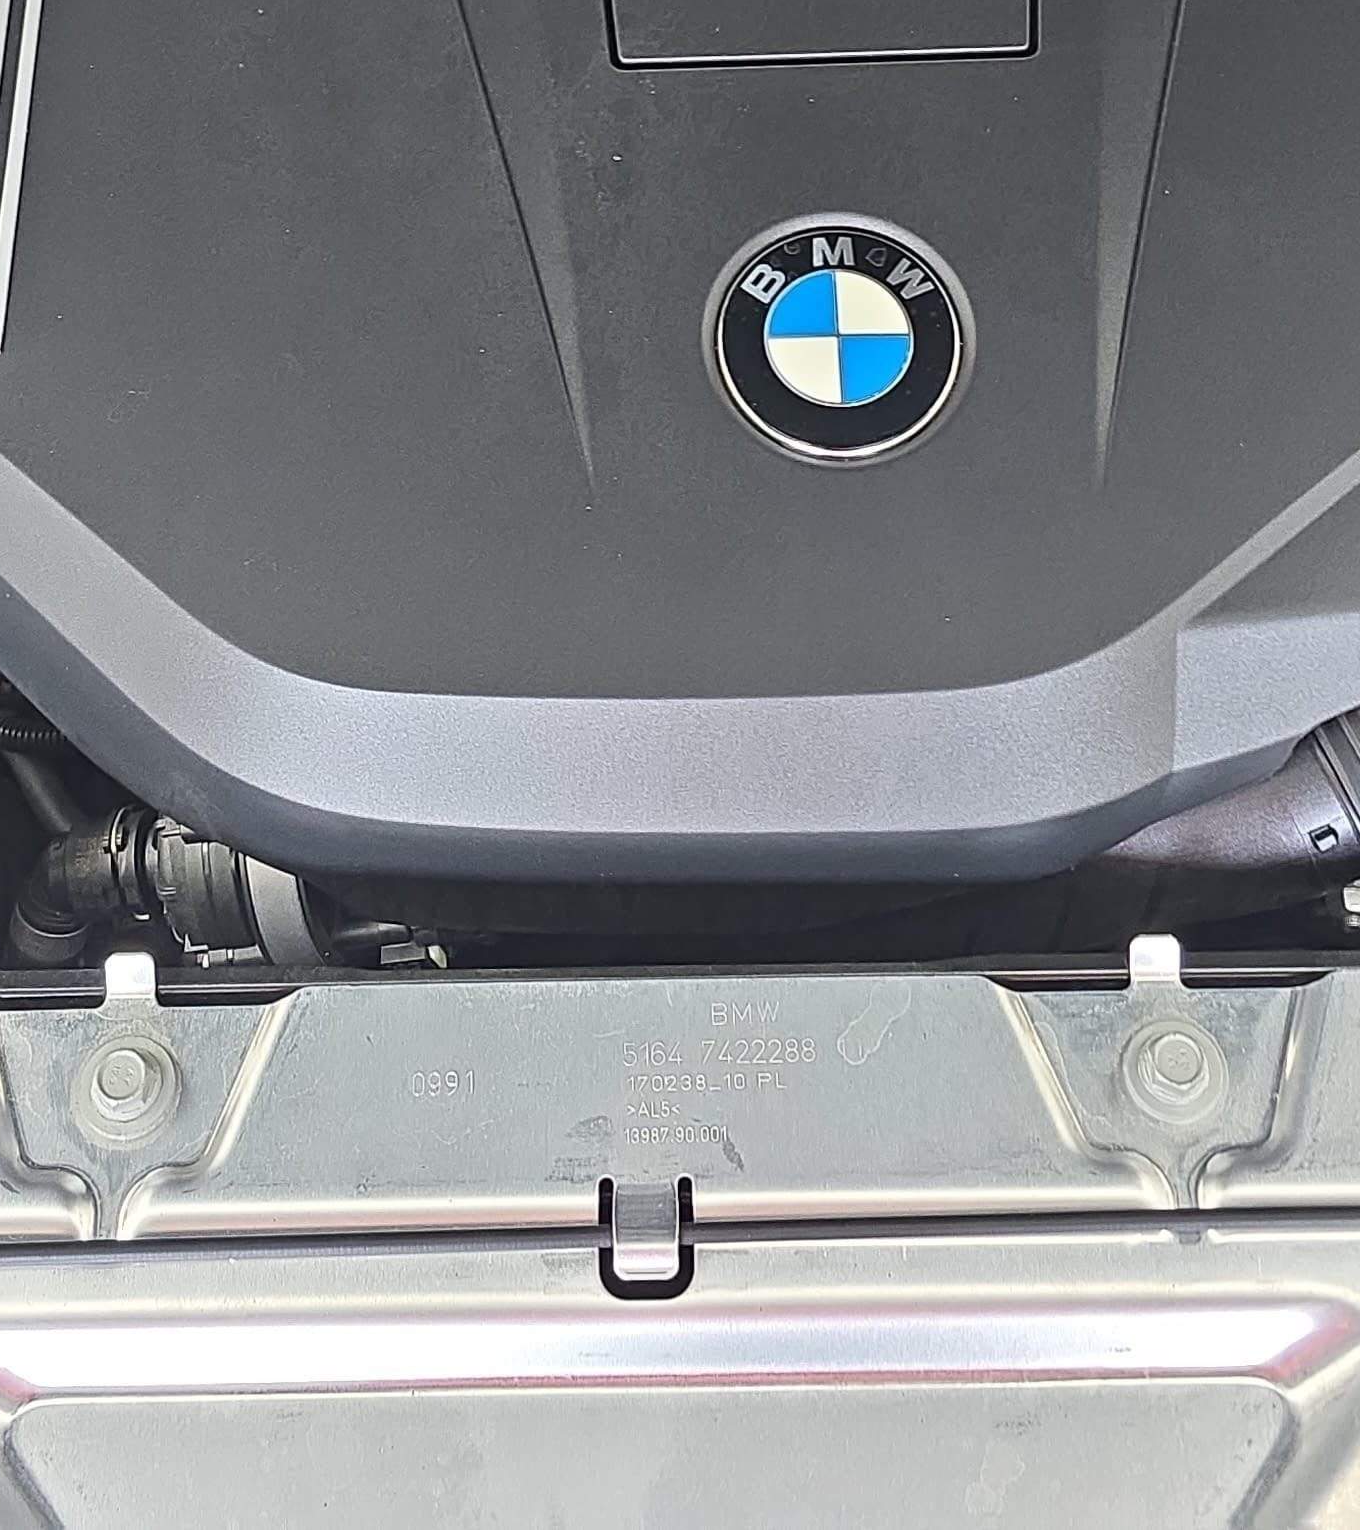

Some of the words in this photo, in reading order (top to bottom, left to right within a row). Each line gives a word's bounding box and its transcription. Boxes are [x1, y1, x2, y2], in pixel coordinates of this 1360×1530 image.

[740, 236, 936, 304] BMW
[711, 1001, 780, 1027] BMW
[623, 1040, 684, 1067] 5164
[700, 1037, 817, 1065] 7422288
[412, 1070, 476, 1097] 0991
[757, 1072, 788, 1090] PL
[623, 1125, 730, 1145] 13987.90.001
